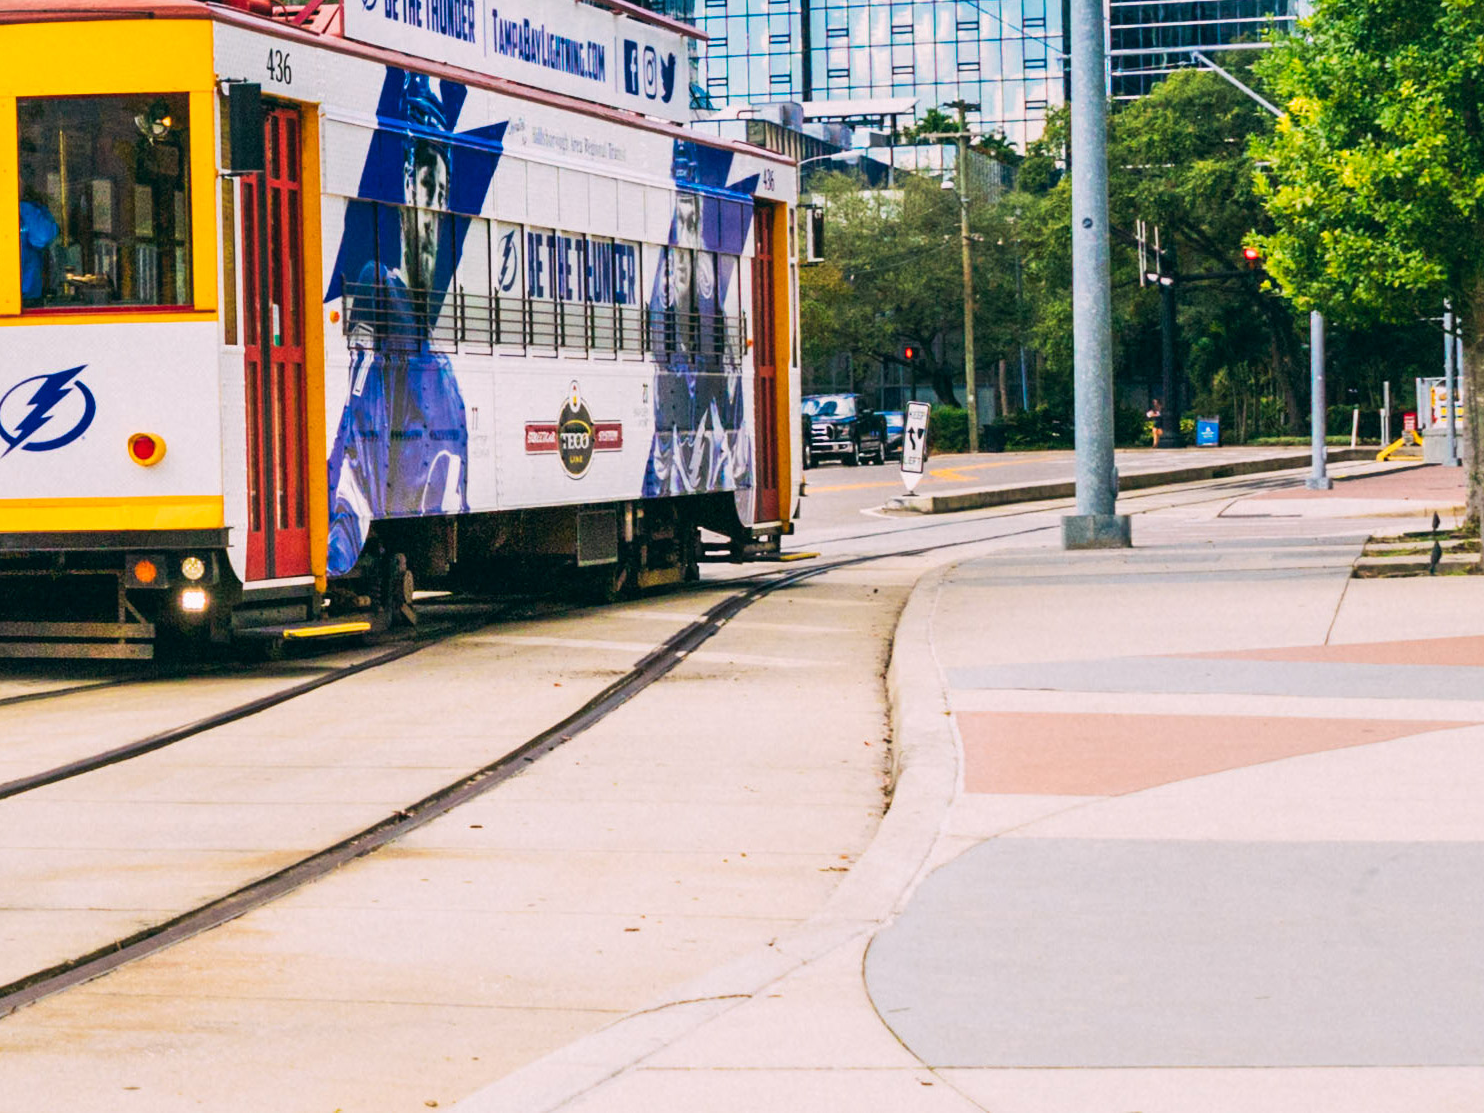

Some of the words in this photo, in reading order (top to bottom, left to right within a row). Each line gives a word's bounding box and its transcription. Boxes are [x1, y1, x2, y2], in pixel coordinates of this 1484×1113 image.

[266, 47, 292, 85] 436
[527, 231, 544, 299] BE
[546, 235, 573, 301] THE
[575, 238, 637, 305] THUNDER
[560, 432, 590, 449] TECO
